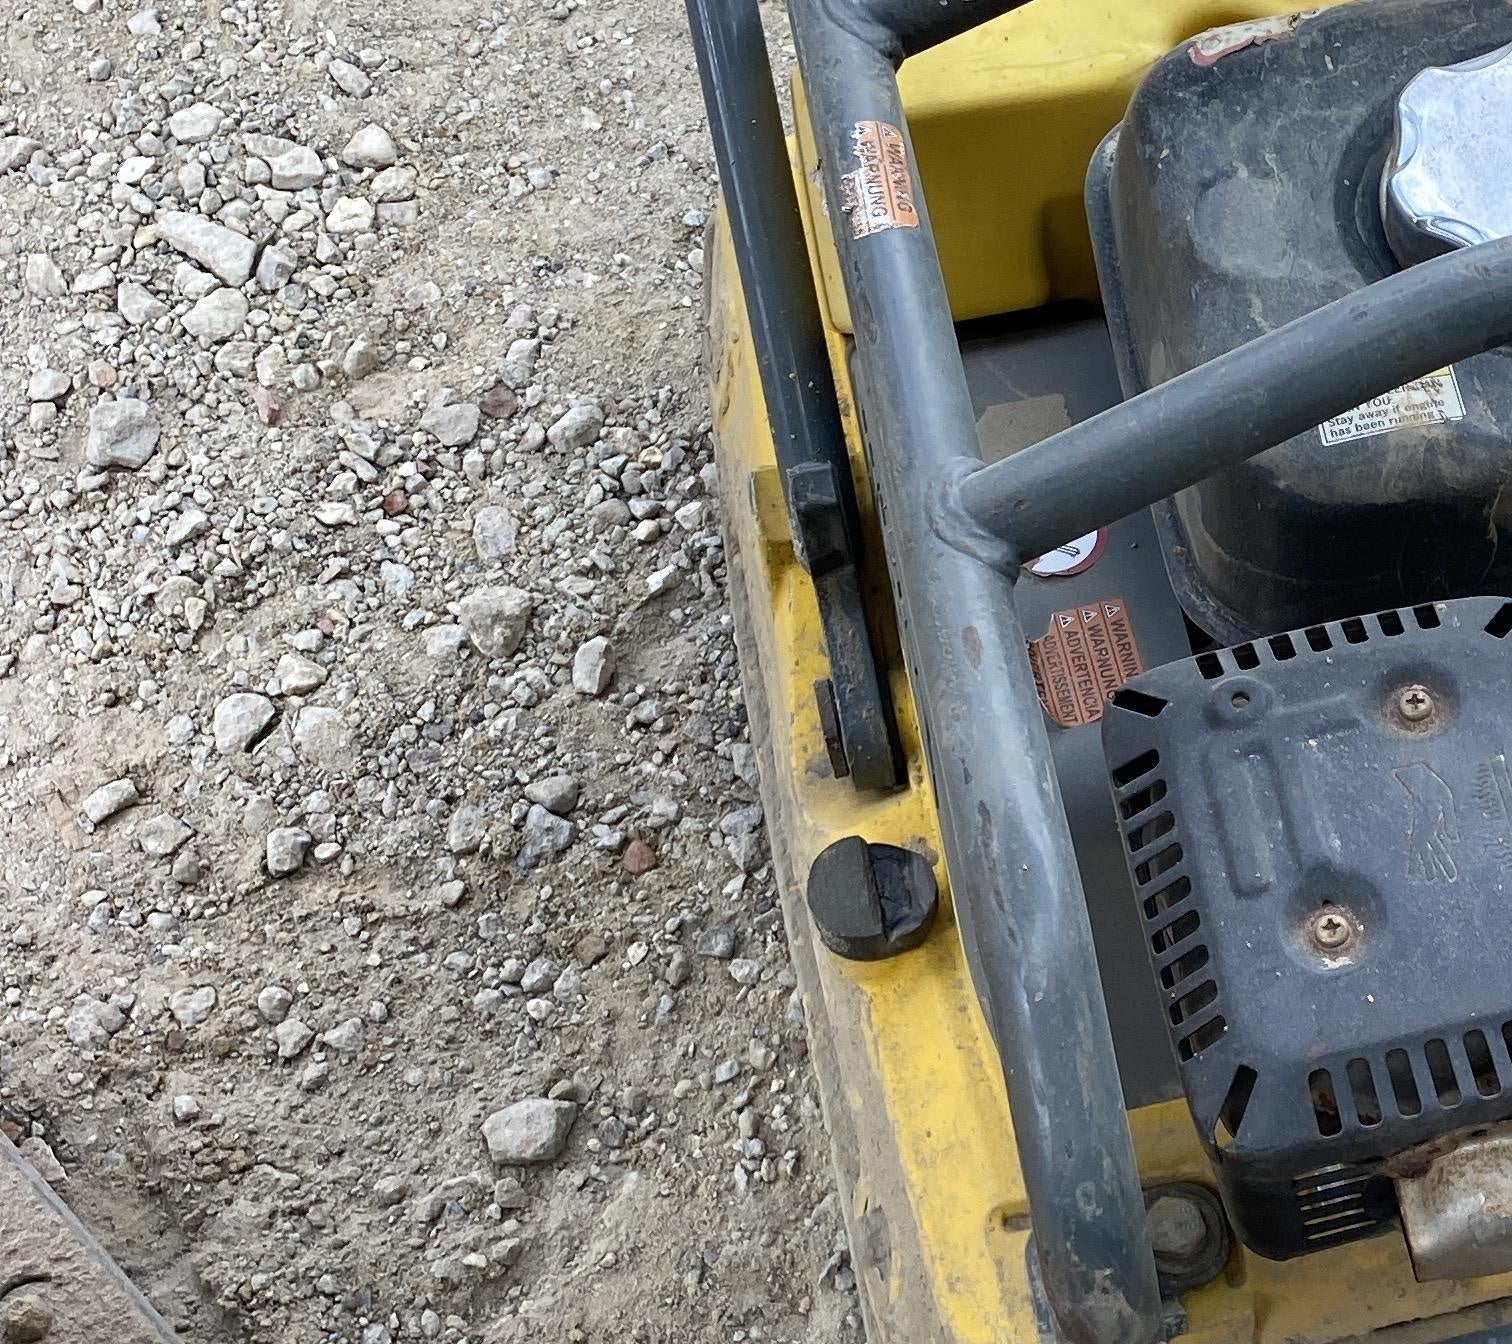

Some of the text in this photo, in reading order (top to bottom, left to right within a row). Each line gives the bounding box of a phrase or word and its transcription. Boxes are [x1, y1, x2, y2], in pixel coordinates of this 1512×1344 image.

[1330, 425, 1352, 439] has
[1355, 419, 1386, 433] been
[1358, 407, 1389, 422] away
[1110, 617, 1140, 678] WARNIN
[1064, 630, 1102, 719] ADVERTENCIA
